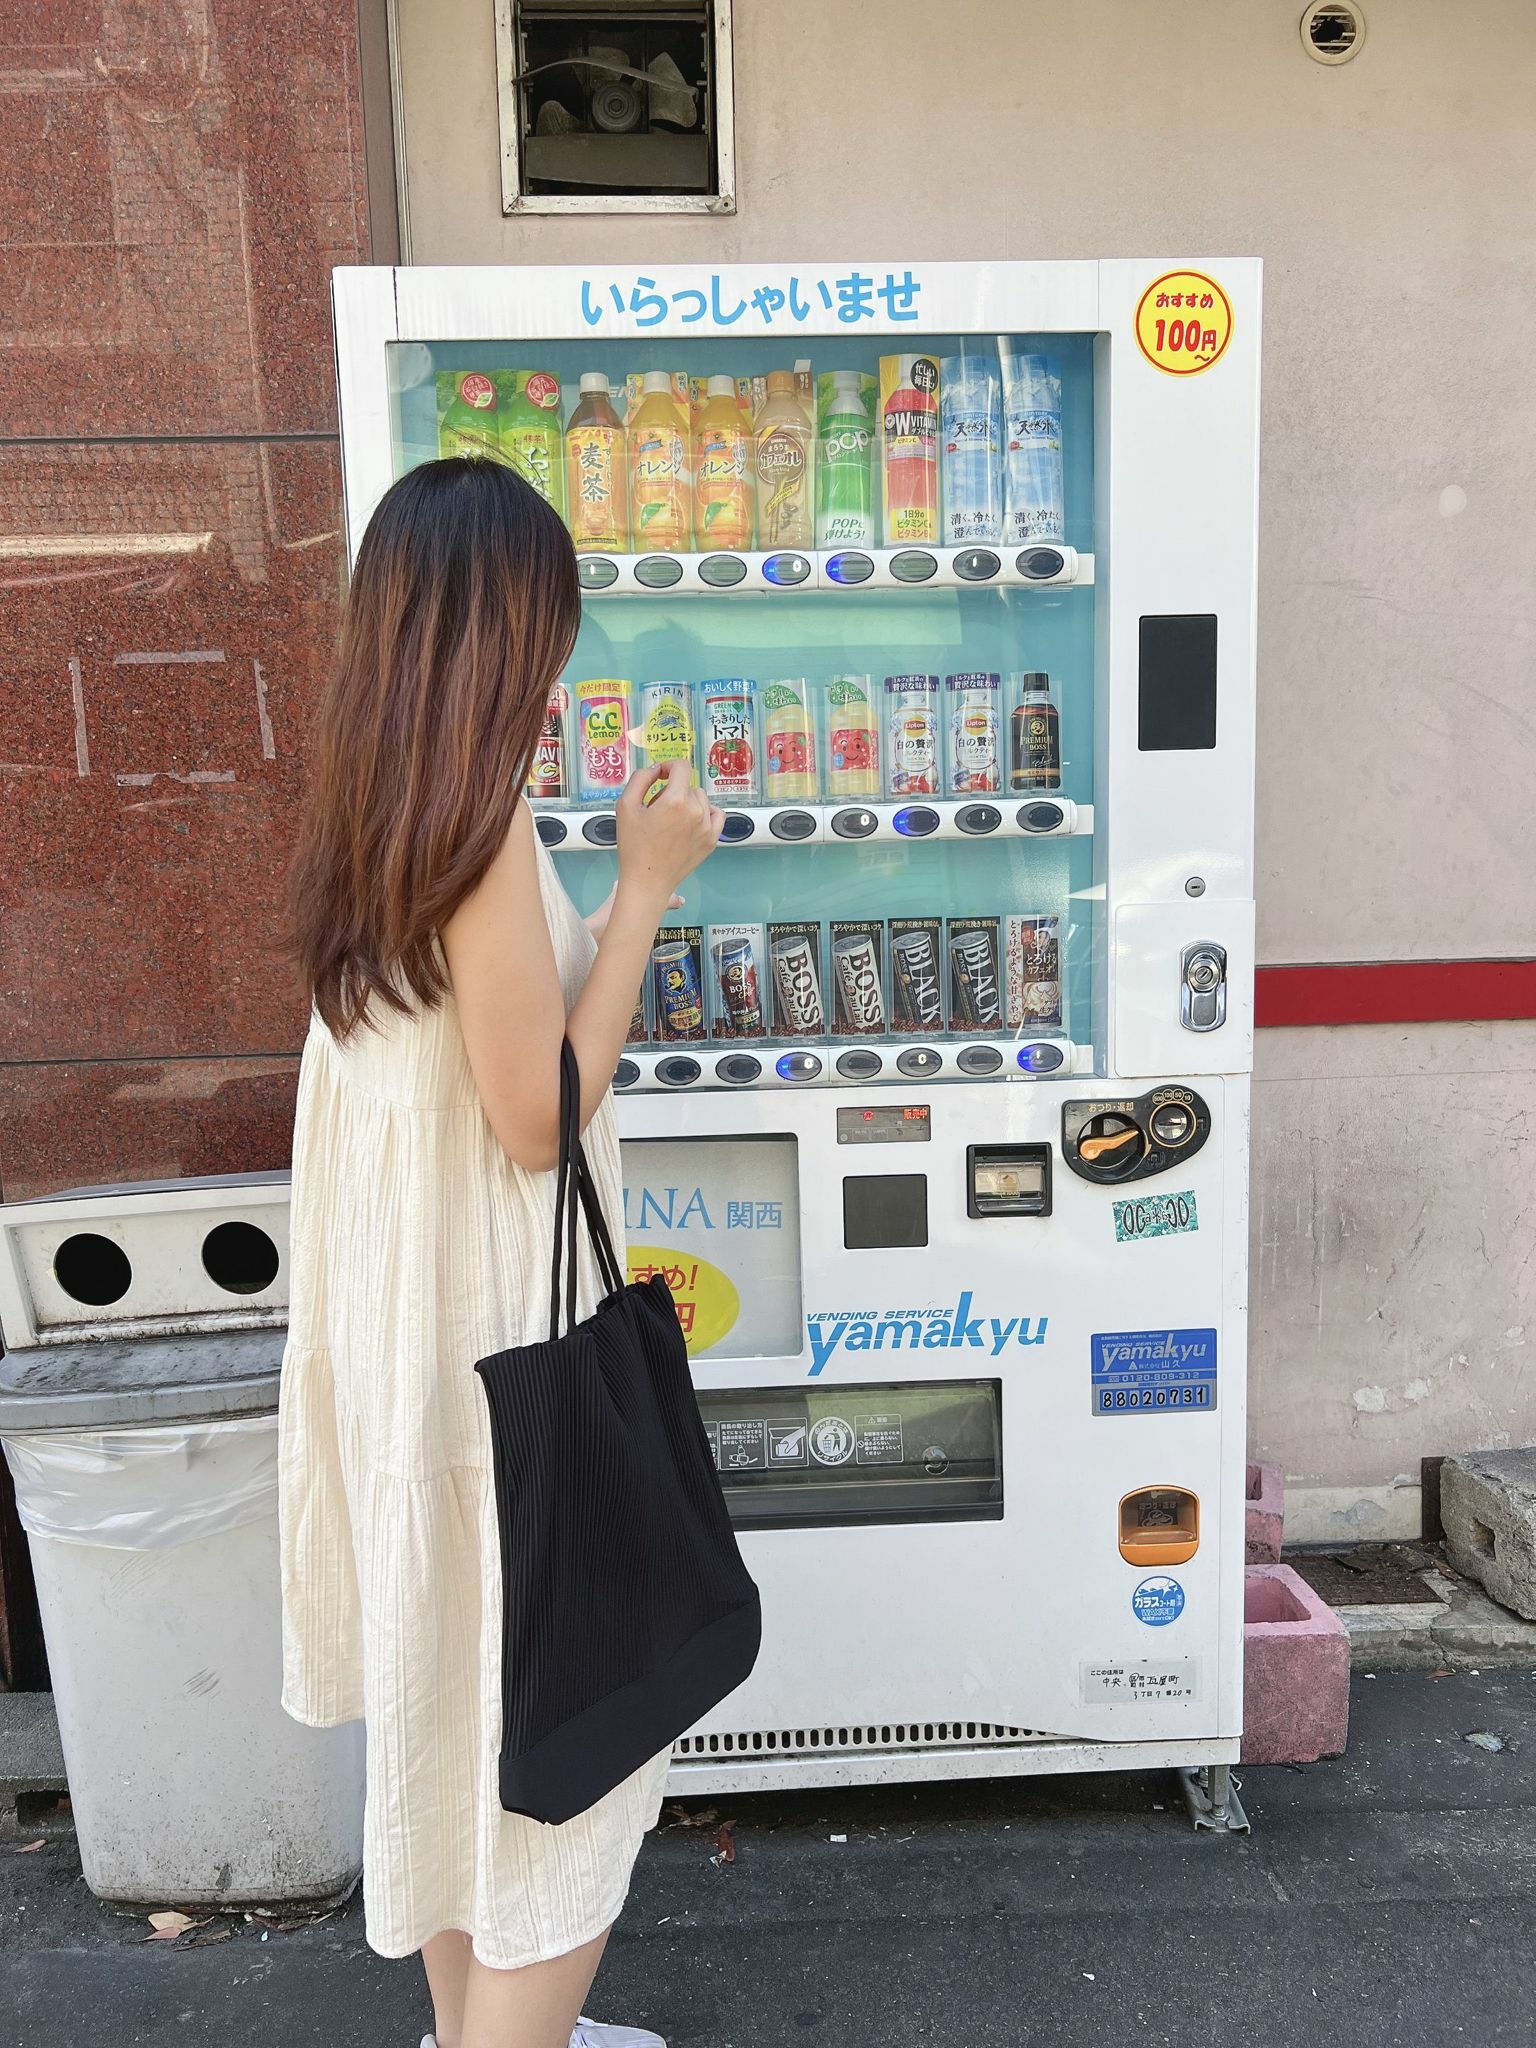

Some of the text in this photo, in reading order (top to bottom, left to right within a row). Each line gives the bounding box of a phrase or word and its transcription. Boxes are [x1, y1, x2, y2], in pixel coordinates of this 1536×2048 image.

[581, 271, 921, 327] いらっしゃいませ
[1155, 292, 1214, 308] おすすめ
[915, 363, 935, 376] 忙しい
[953, 420, 993, 438] 天然水
[1016, 420, 1056, 437] 天然水
[760, 451, 802, 471] カフェオレ
[580, 442, 610, 503] 麦茶
[637, 460, 681, 476] オレンジ
[700, 460, 745, 477] オレンジ
[903, 509, 925, 518] 1日分の
[831, 518, 865, 529] POPに
[824, 529, 866, 541] 弾けよう!
[704, 680, 754, 694] おいしく野菜!
[893, 682, 935, 692] 贅沢な味わい
[954, 680, 997, 690] 贅沢な味わい
[651, 686, 685, 698] KIRIN
[589, 712, 621, 730] C.C.
[709, 714, 750, 725] すっきりした
[905, 721, 925, 729] Lipton
[966, 720, 987, 728] Lipton
[589, 729, 620, 739] Lemon
[646, 733, 693, 742] キリンレモン
[714, 723, 749, 740] トマト
[588, 746, 622, 767] もも
[589, 767, 624, 780] ミックス
[712, 927, 760, 936] 爽やかアイスコーヒー
[770, 924, 818, 933] まろやかで深いコク
[833, 923, 882, 932] まろやかで深いコク
[1026, 953, 1057, 965] とろける
[729, 981, 752, 994] BOSS
[786, 949, 820, 1024] BOSS
[848, 948, 881, 1023] BOSS
[904, 940, 940, 1023] BLACK
[963, 940, 999, 1023] BLACK
[664, 988, 697, 1004] PREMIUM
[673, 1000, 692, 1010] BOSS
[1088, 1102, 1134, 1112] おつり・返却
[903, 1108, 928, 1120] 販売中
[727, 1201, 783, 1230] 関西
[807, 1309, 954, 1322] VENDING SERVICE
[807, 1291, 1048, 1376] yamakyu
[1102, 1333, 1207, 1372] yamakyu
[1103, 1387, 1203, 1408] 88020731
[817, 1450, 848, 1462] リサイクル
[1102, 1677, 1122, 1688] 中央
